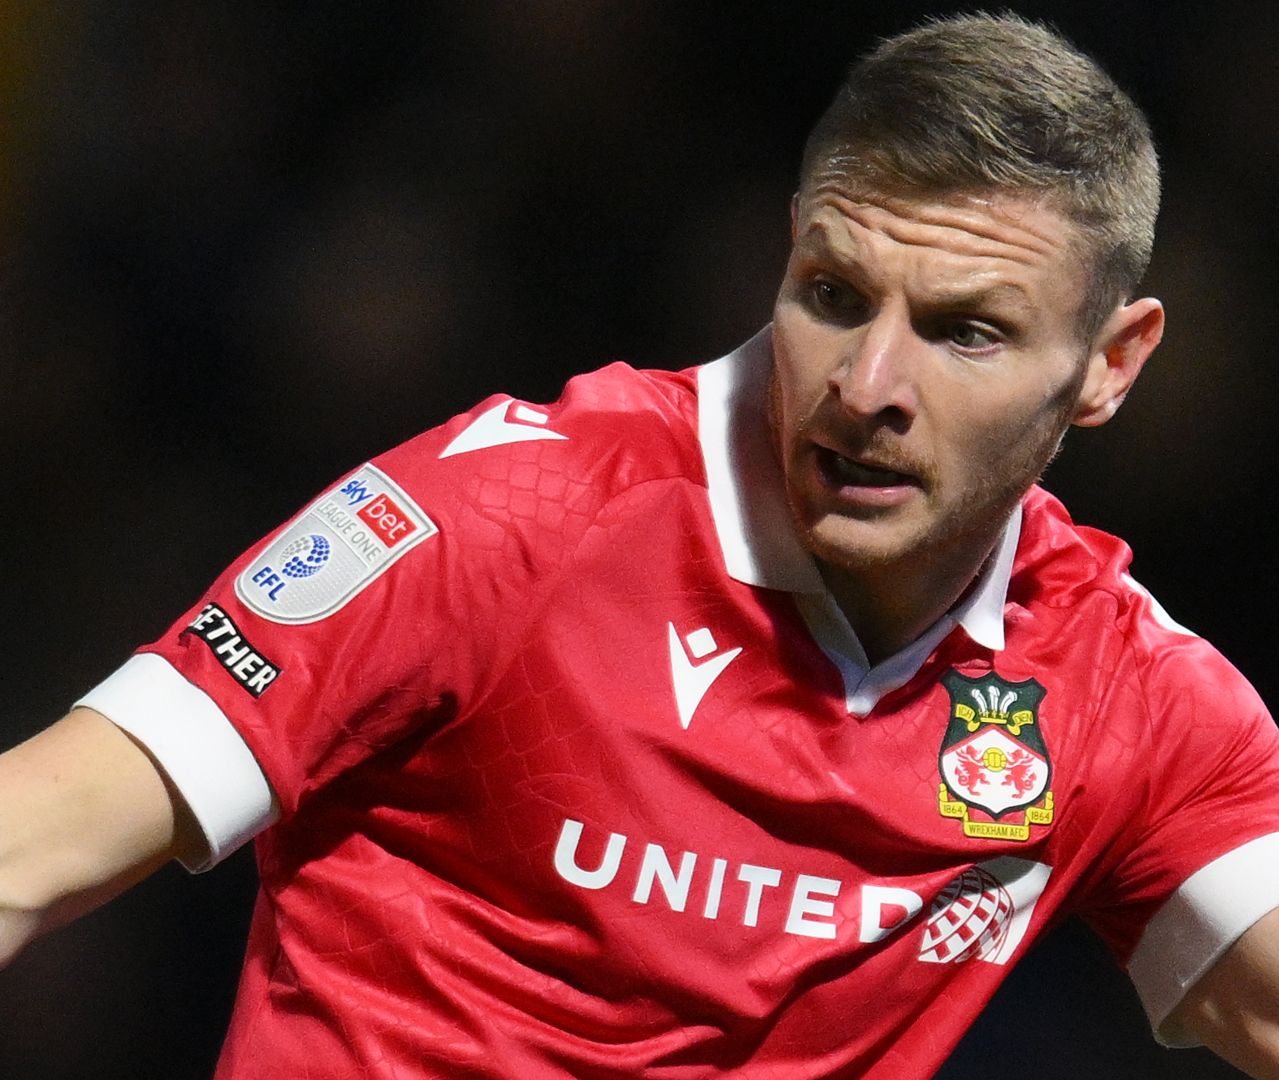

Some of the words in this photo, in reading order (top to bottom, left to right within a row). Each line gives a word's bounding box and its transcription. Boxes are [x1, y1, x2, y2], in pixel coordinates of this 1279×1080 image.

[317, 500, 358, 535] LEAGUE
[351, 527, 381, 562] ONE
[340, 479, 374, 506] sky
[365, 497, 407, 540] bet
[252, 565, 288, 602] EFL
[190, 605, 277, 693] ETHER
[968, 824, 1009, 837] WREXHAM
[1009, 828, 1025, 838] AFC
[553, 818, 923, 944] UNITED
